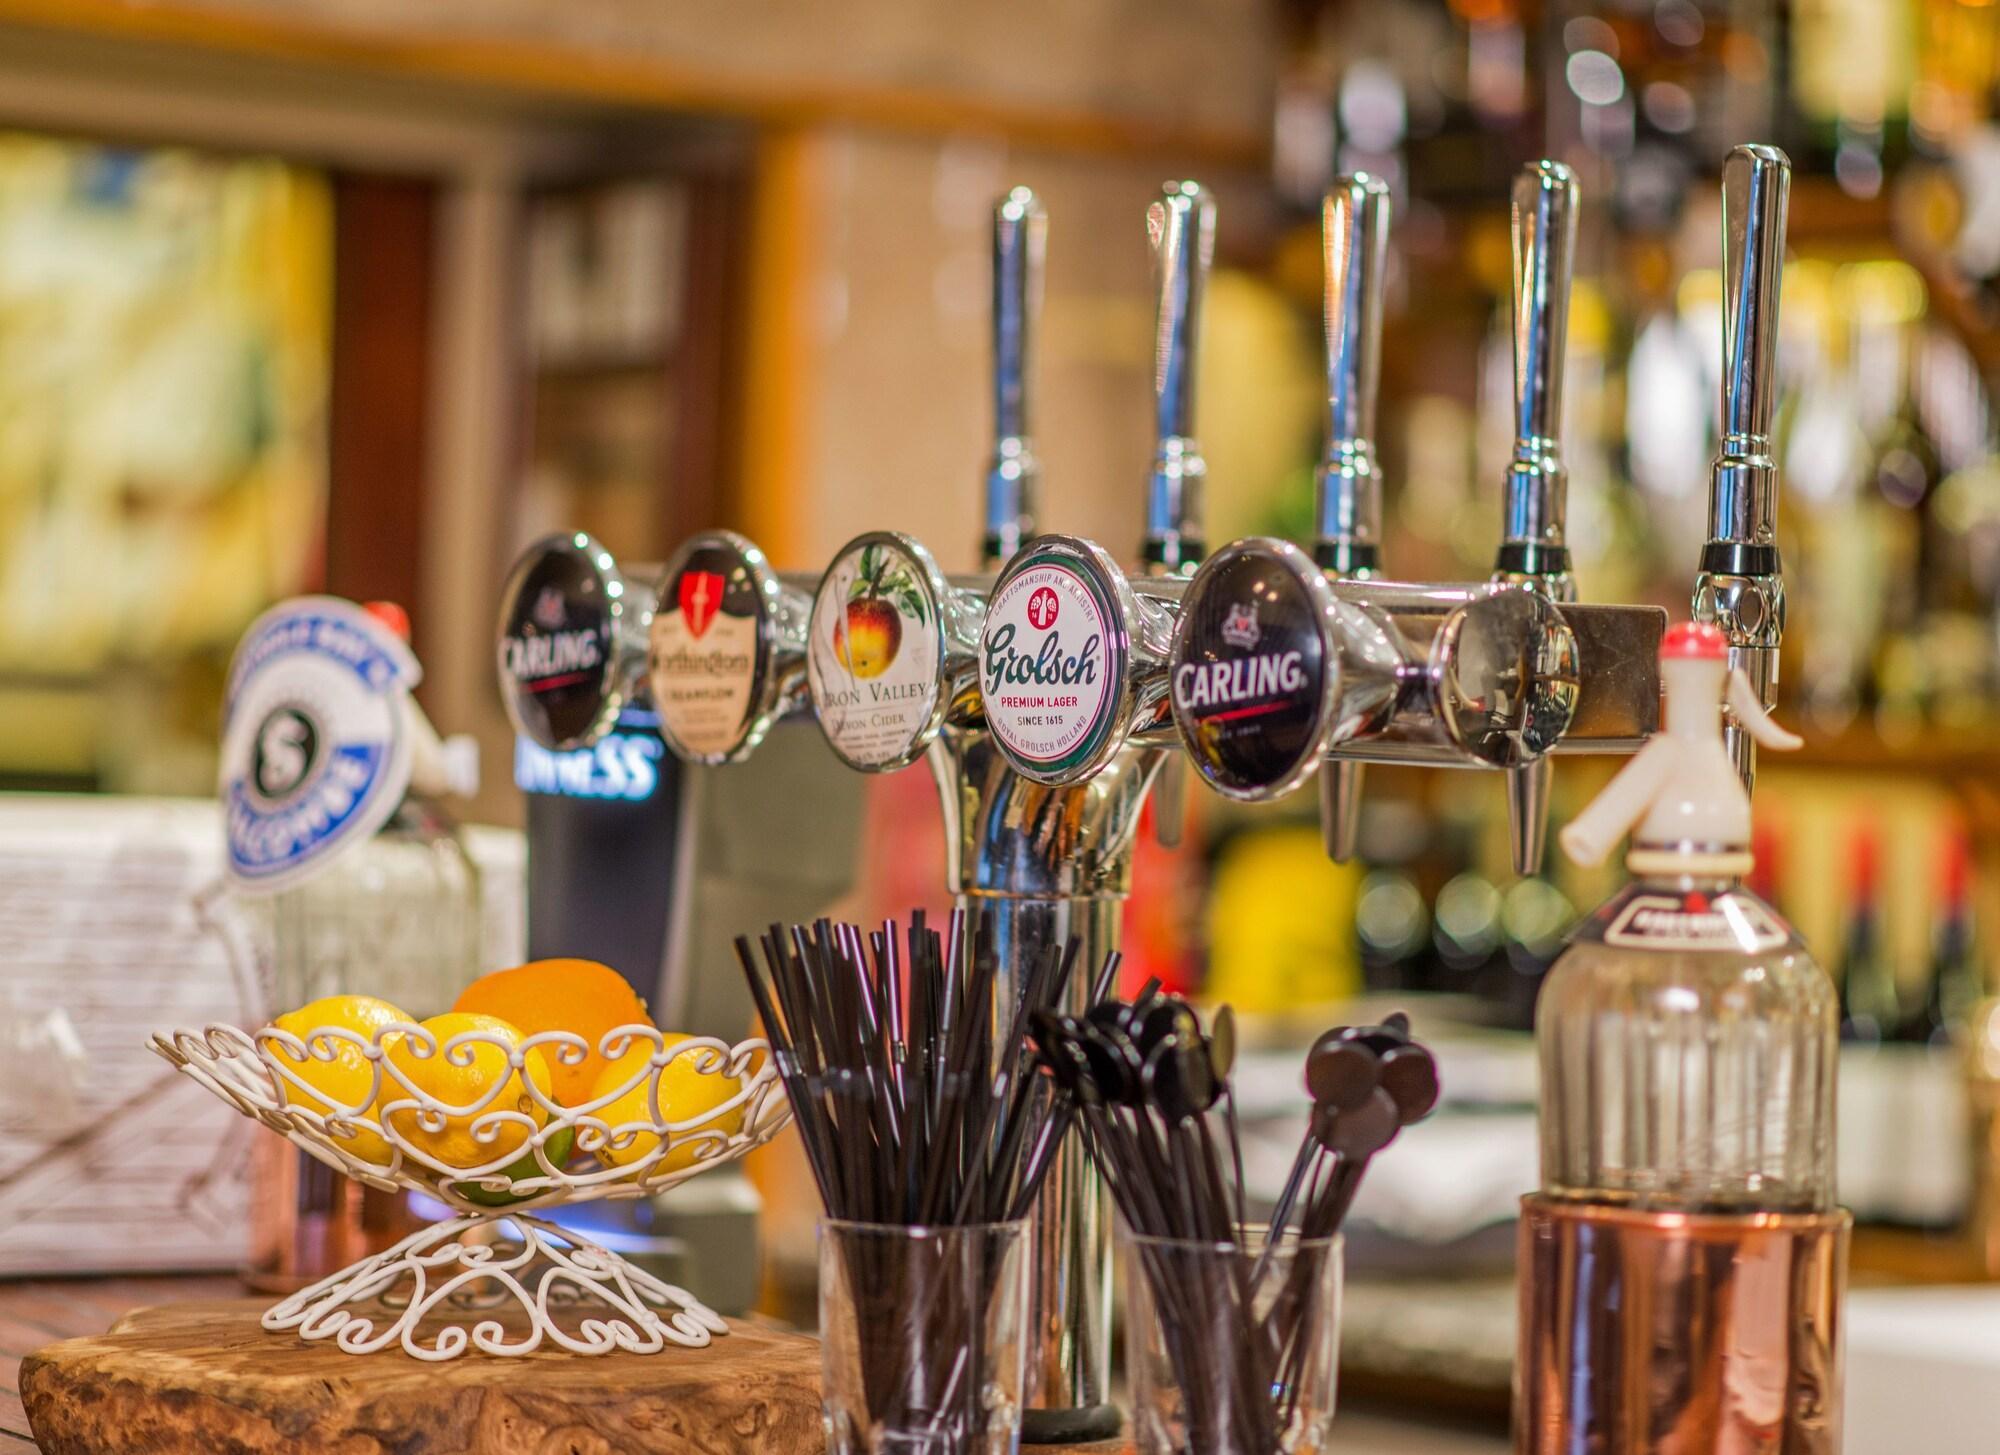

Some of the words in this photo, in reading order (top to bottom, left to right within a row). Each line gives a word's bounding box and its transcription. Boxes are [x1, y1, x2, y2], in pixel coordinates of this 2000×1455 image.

[995, 574, 1052, 616] CRAFTSMANSHIP
[985, 623, 1100, 696] Grolsch
[869, 682, 927, 702] VALLEY
[1175, 651, 1302, 709] CARLING
[1001, 696, 1045, 708] PREMIUM
[1047, 696, 1078, 708] LAGER
[1017, 715, 1043, 726] SINCE
[1045, 715, 1064, 725] 1615
[997, 718, 1018, 745] ROYAL
[1020, 738, 1055, 753] GROLSCH
[1057, 715, 1087, 748] HOLLAND
